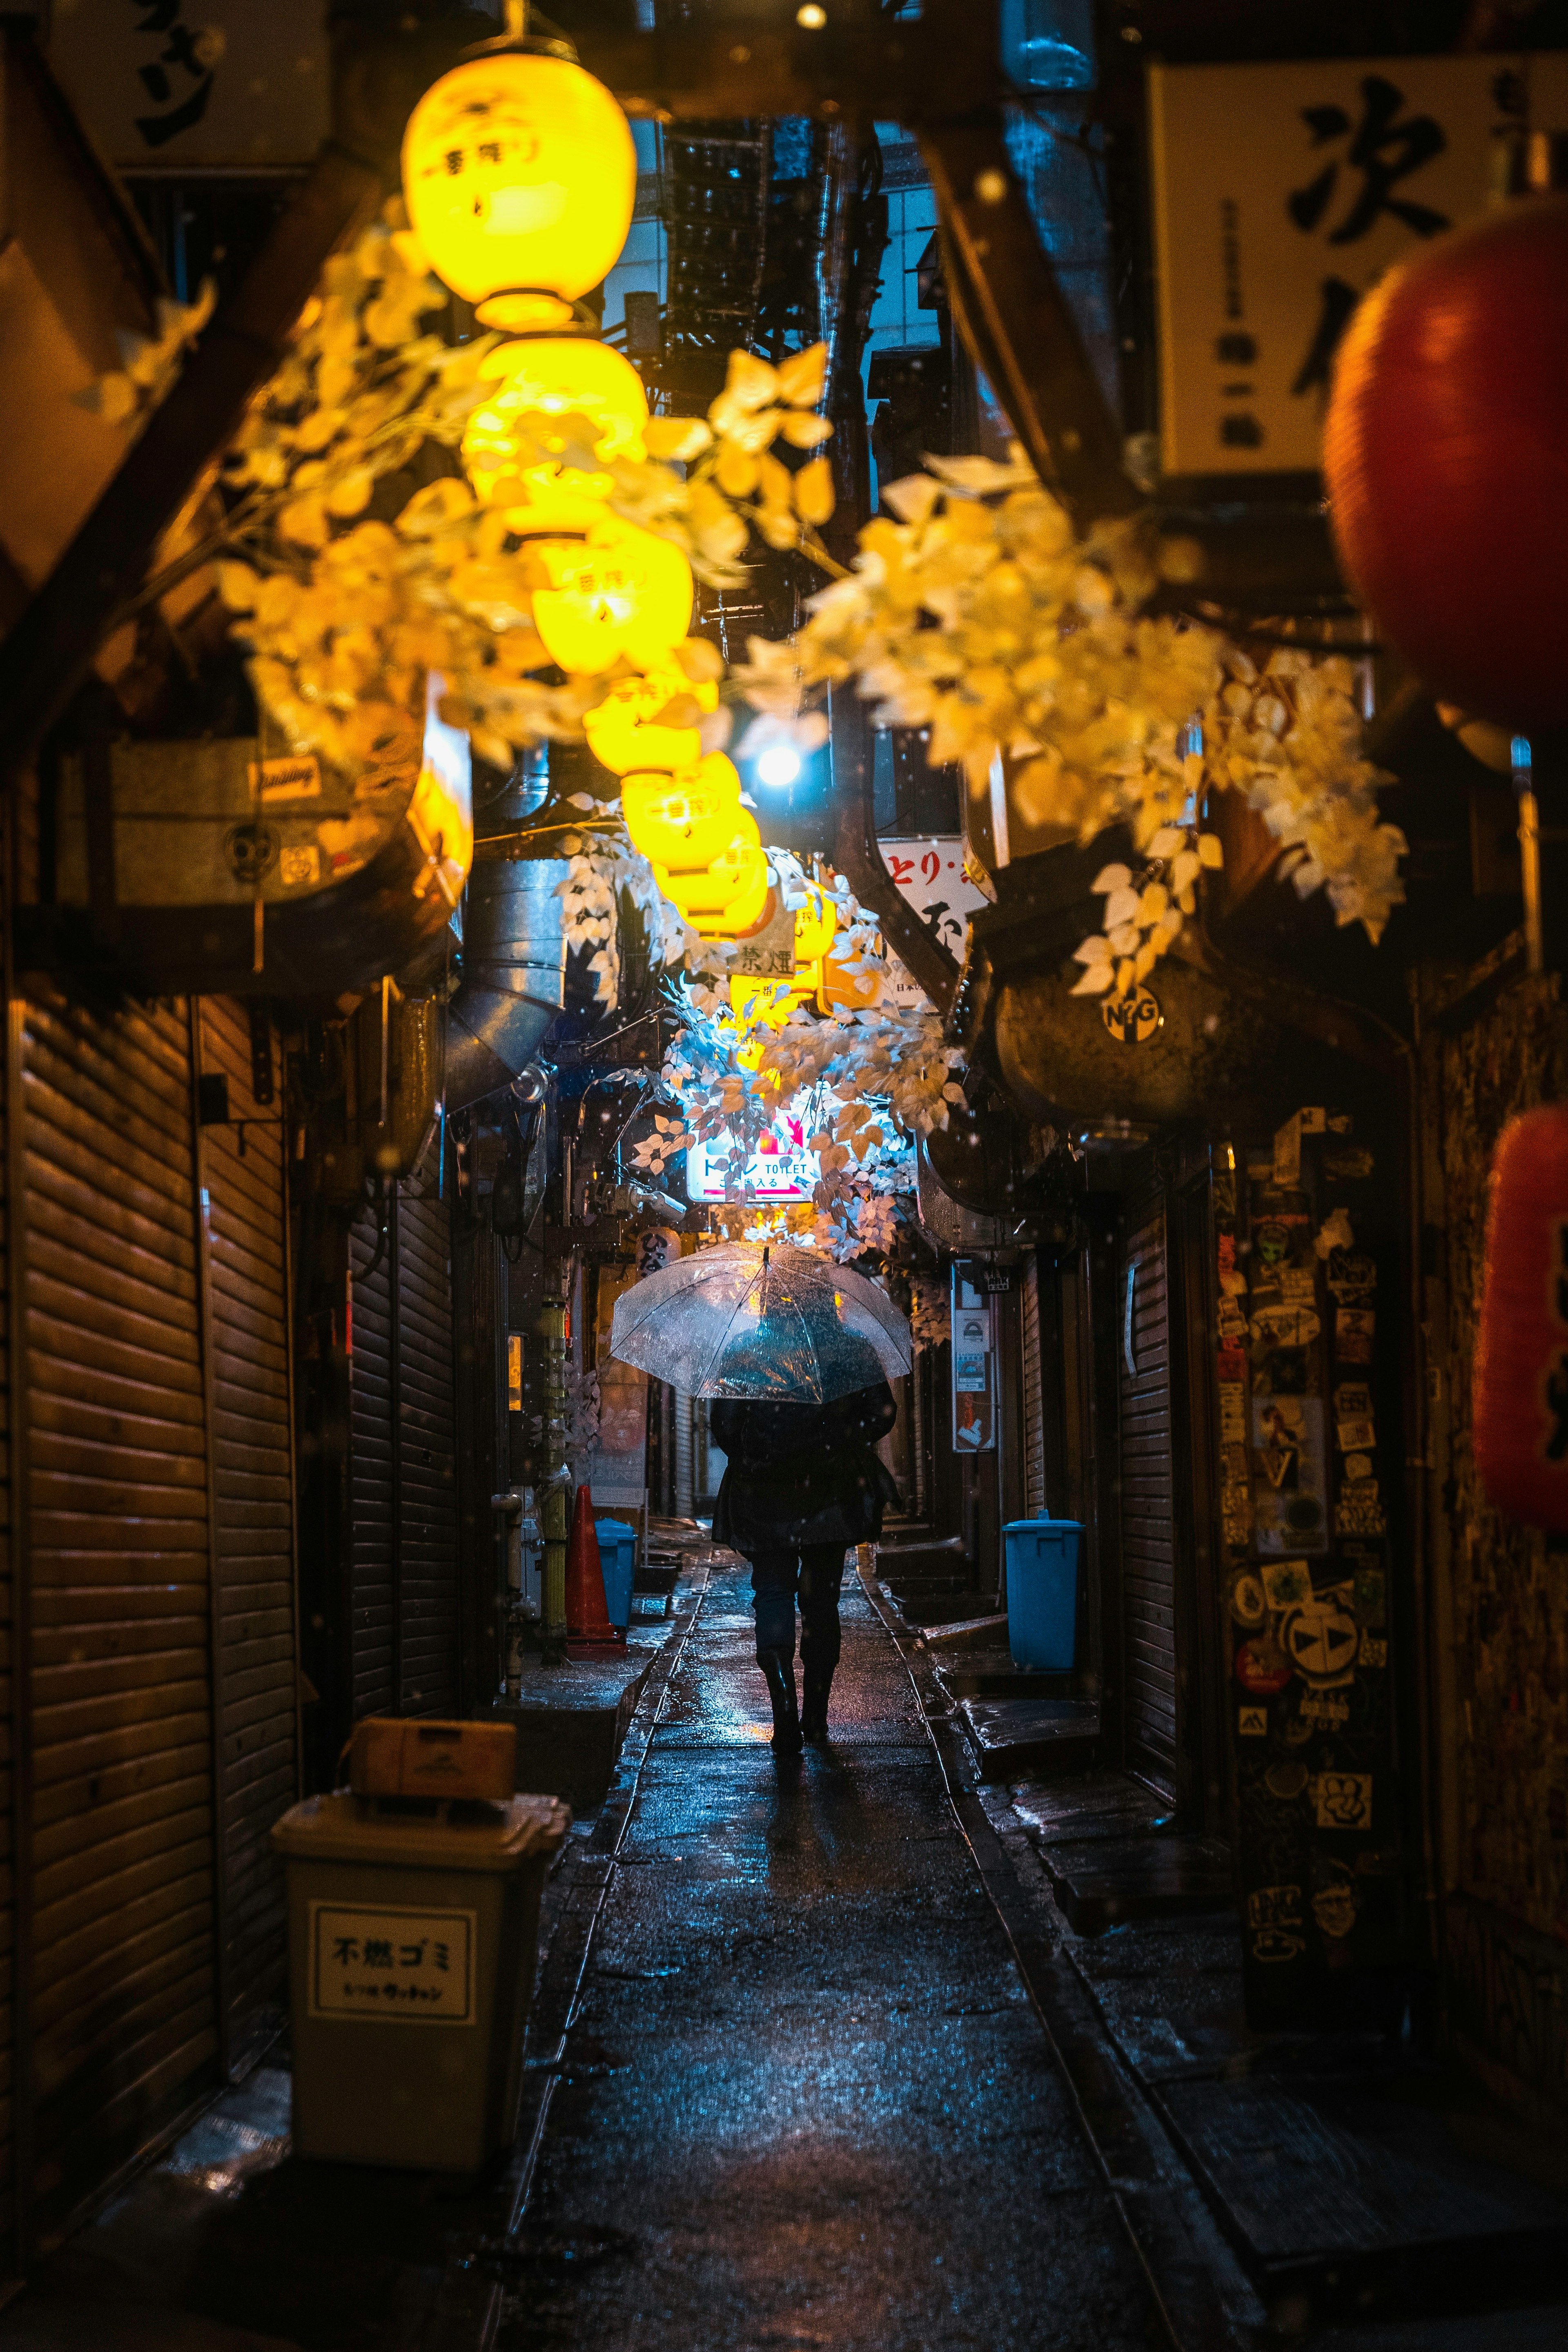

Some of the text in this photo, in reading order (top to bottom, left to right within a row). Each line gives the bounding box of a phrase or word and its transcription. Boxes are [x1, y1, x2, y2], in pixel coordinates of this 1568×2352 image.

[650, 797, 721, 817] 一番搾り
[742, 945, 793, 974] 禁煙
[705, 1159, 758, 1176] トレ
[765, 1164, 807, 1174] TOILET
[333, 1937, 449, 1971] 不燃ゴミ
